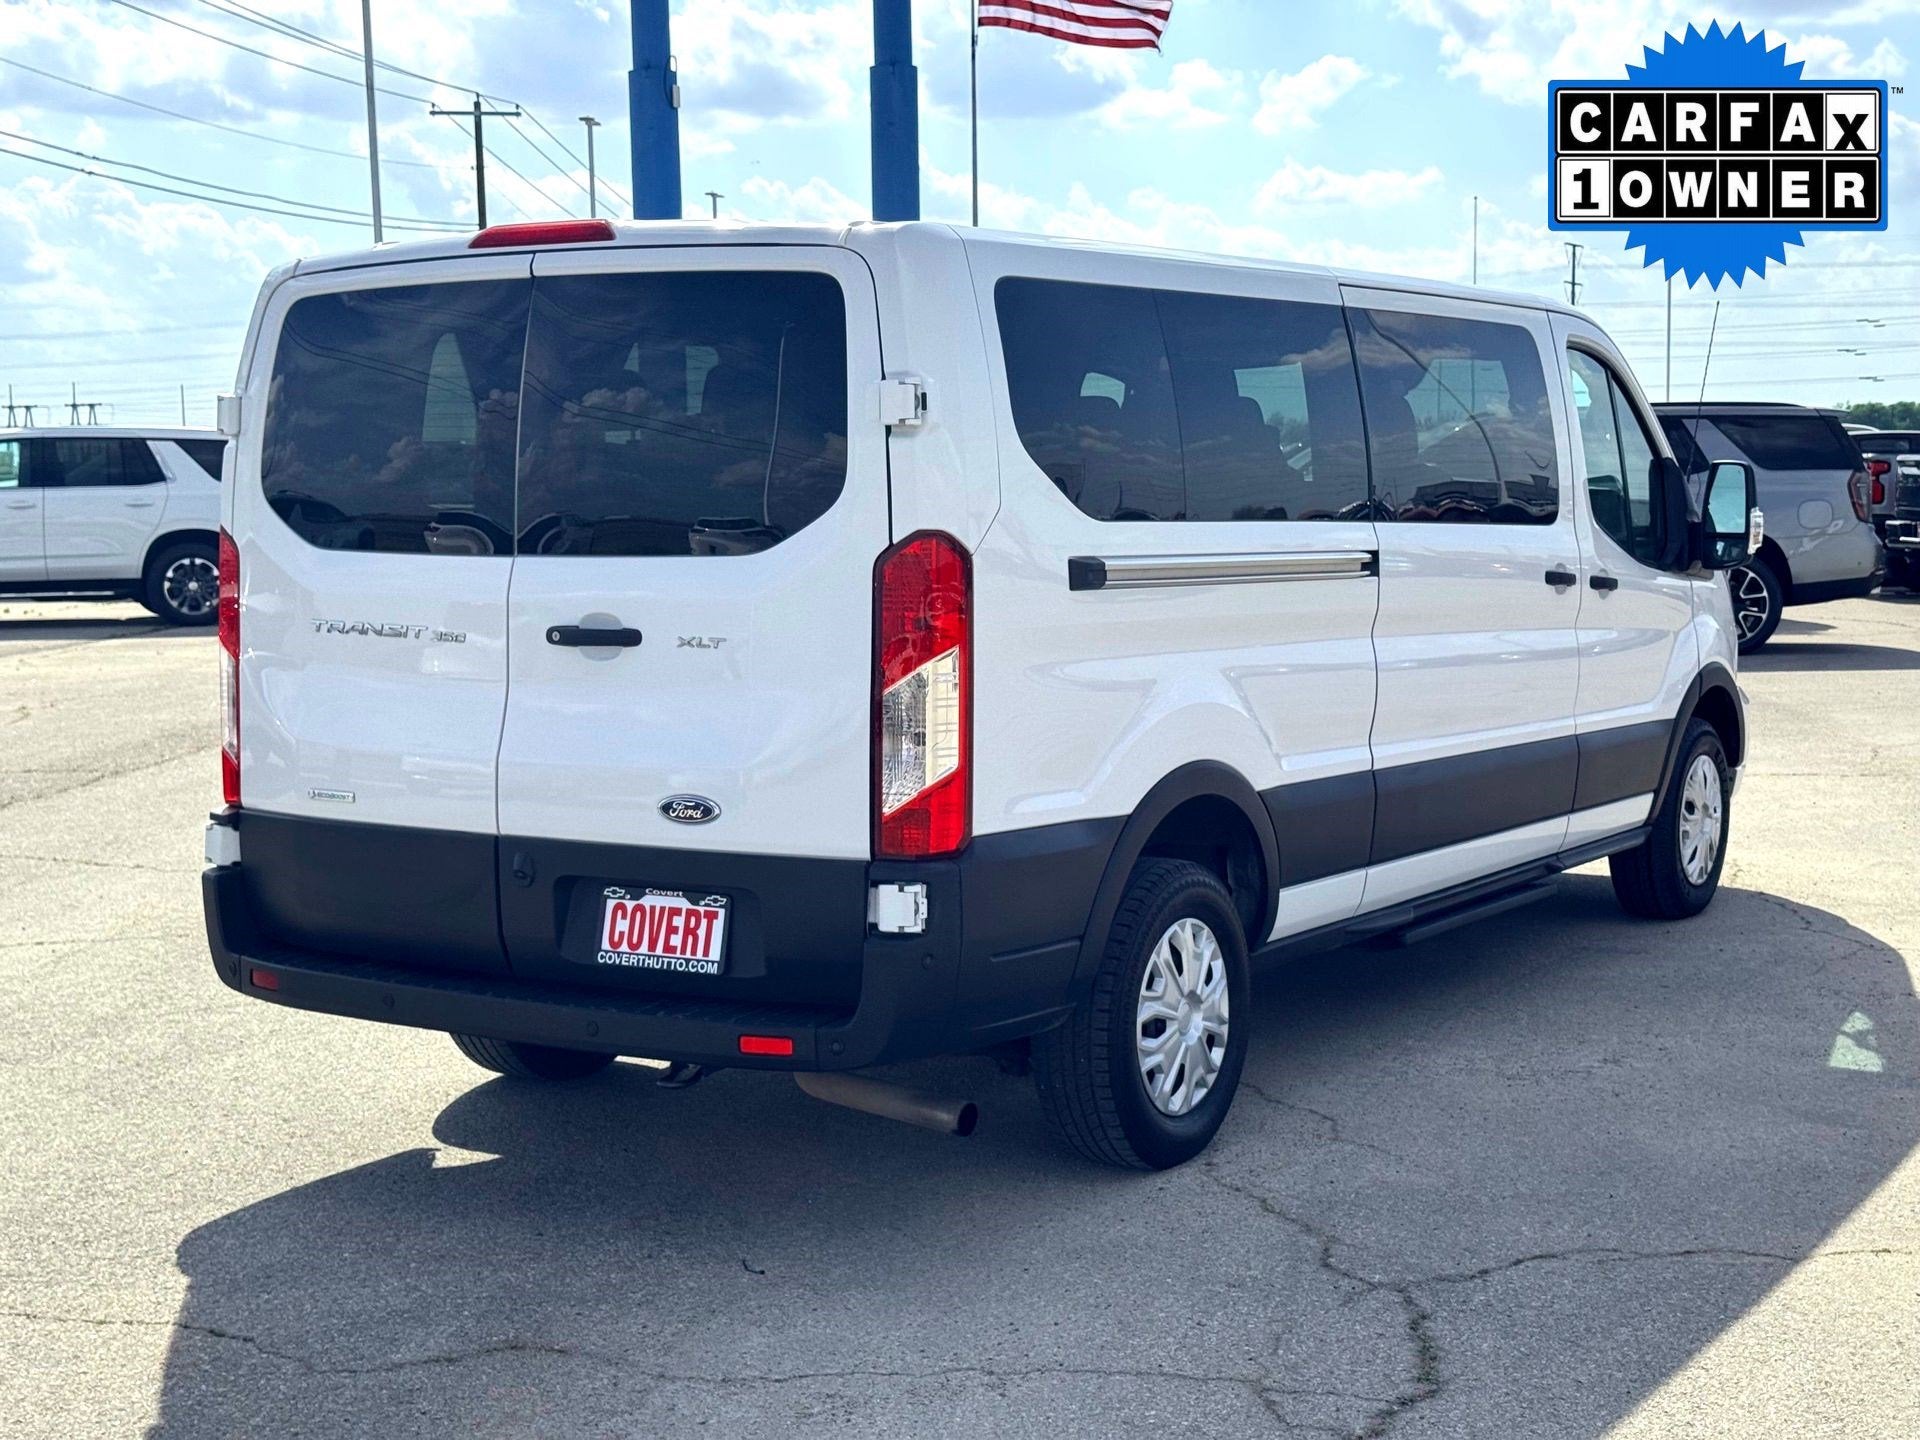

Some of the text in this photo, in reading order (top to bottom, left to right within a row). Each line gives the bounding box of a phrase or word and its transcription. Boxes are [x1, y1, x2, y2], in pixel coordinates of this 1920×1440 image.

[311, 618, 467, 643] TRANSIT 350
[676, 635, 727, 649] XLT
[669, 800, 704, 818] Ford
[645, 887, 683, 898] Covert
[608, 901, 719, 958] COVERT
[597, 951, 719, 974] COVERTHUTTO.COM
